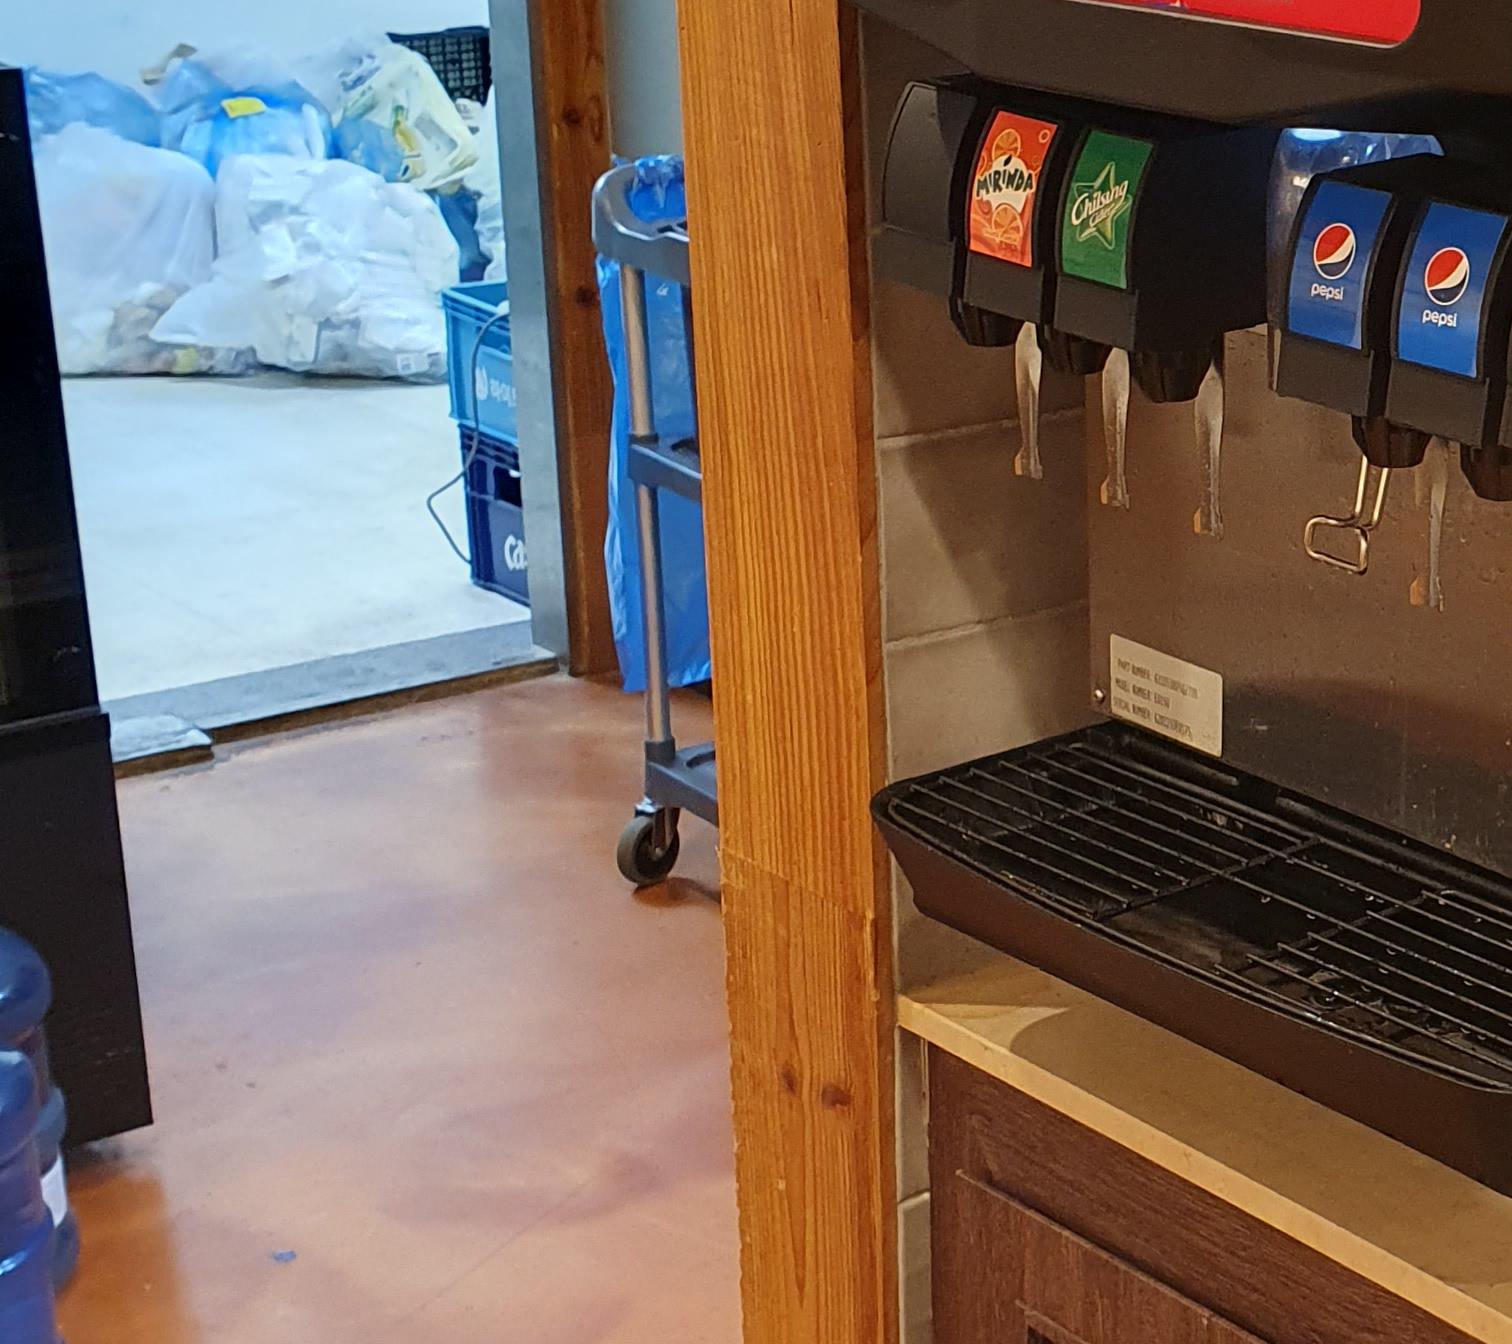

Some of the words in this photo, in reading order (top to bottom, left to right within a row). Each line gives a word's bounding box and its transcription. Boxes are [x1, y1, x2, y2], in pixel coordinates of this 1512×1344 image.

[976, 168, 1034, 198] MIRINDA
[1071, 180, 1129, 226] Chilsung
[1311, 282, 1345, 301] pepsi
[1422, 309, 1457, 328] pepsi
